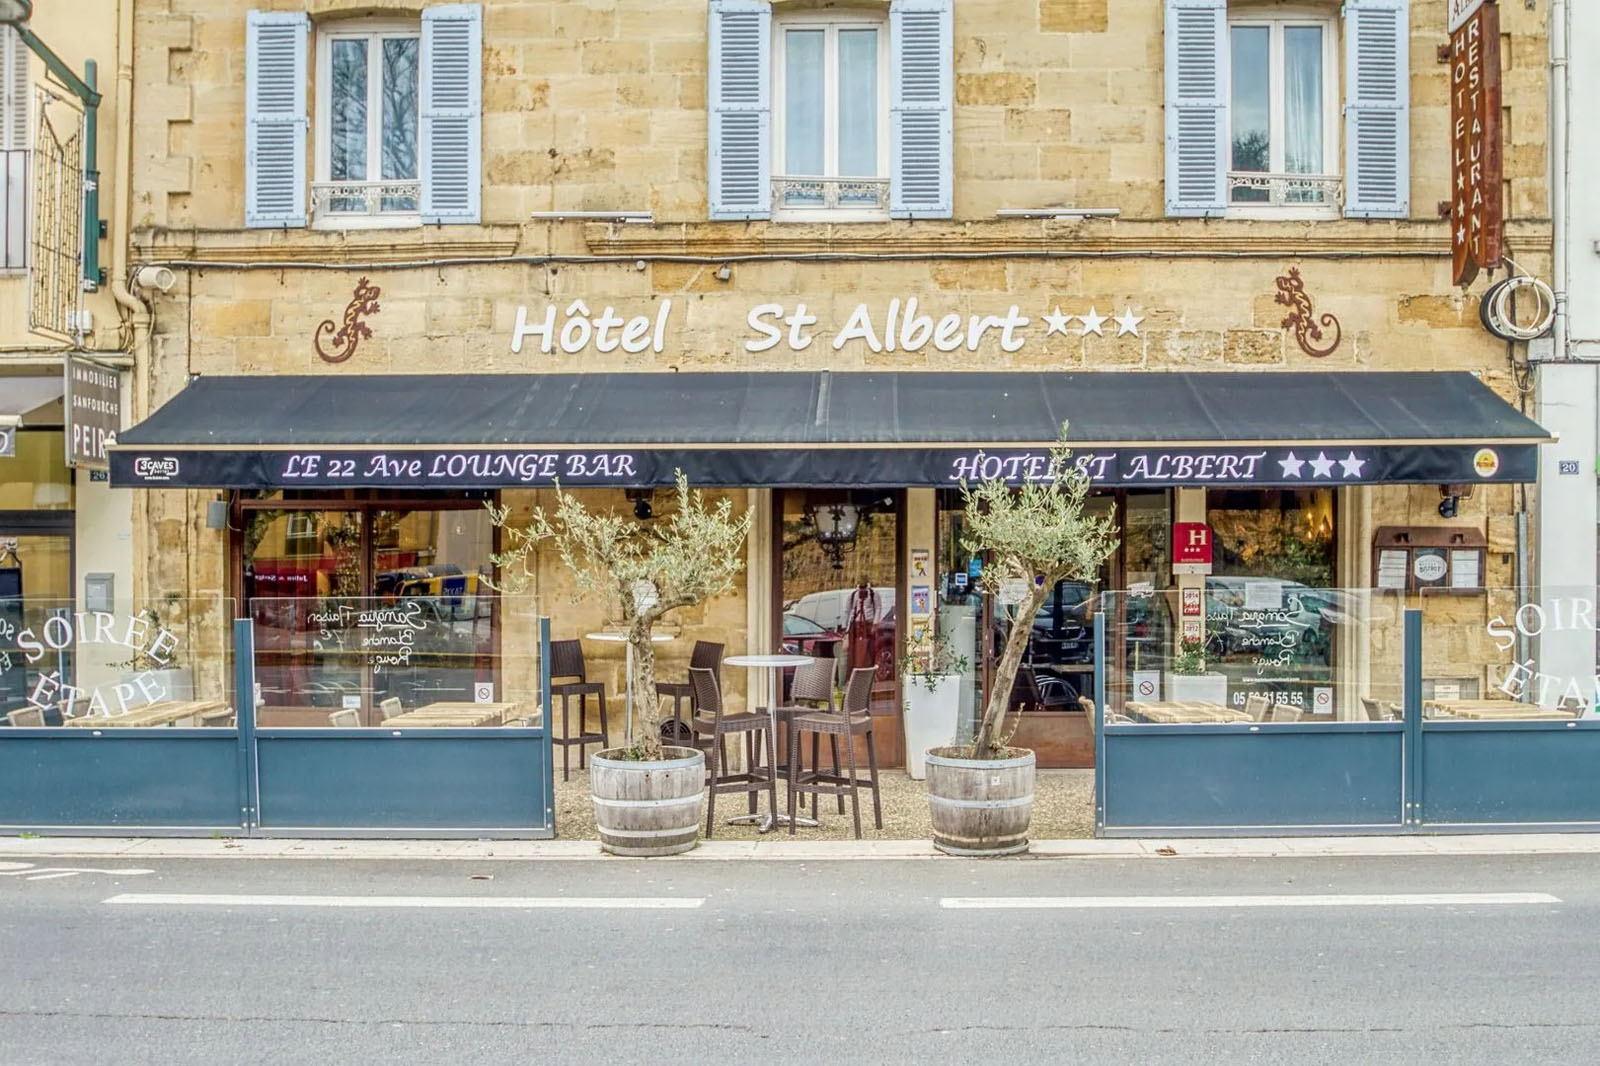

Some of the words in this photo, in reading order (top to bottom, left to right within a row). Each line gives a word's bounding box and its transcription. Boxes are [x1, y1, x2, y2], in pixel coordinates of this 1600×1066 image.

[1455, 32, 1465, 166] HOTEL
[1468, 18, 1482, 255] RESTAURANT
[511, 299, 671, 353] Hôtel
[745, 303, 817, 352] St
[832, 296, 1031, 353] Albert
[73, 367, 117, 389] IMMOBILIER
[282, 455, 320, 477] LE
[326, 459, 355, 477] 22
[363, 454, 422, 477] Ave
[428, 454, 557, 481] LOUNGE
[565, 454, 637, 477] BAR
[1122, 451, 1266, 479] ALBERT
[1562, 463, 1576, 472] 20
[1189, 530, 1208, 545] H
[16, 608, 179, 664] SOIRÉE
[1487, 598, 1600, 652] SOIR
[26, 670, 166, 718] ÉTAPE
[1233, 692, 1246, 705] 05
[1276, 692, 1289, 705] 55
[1291, 692, 1304, 705] 55
